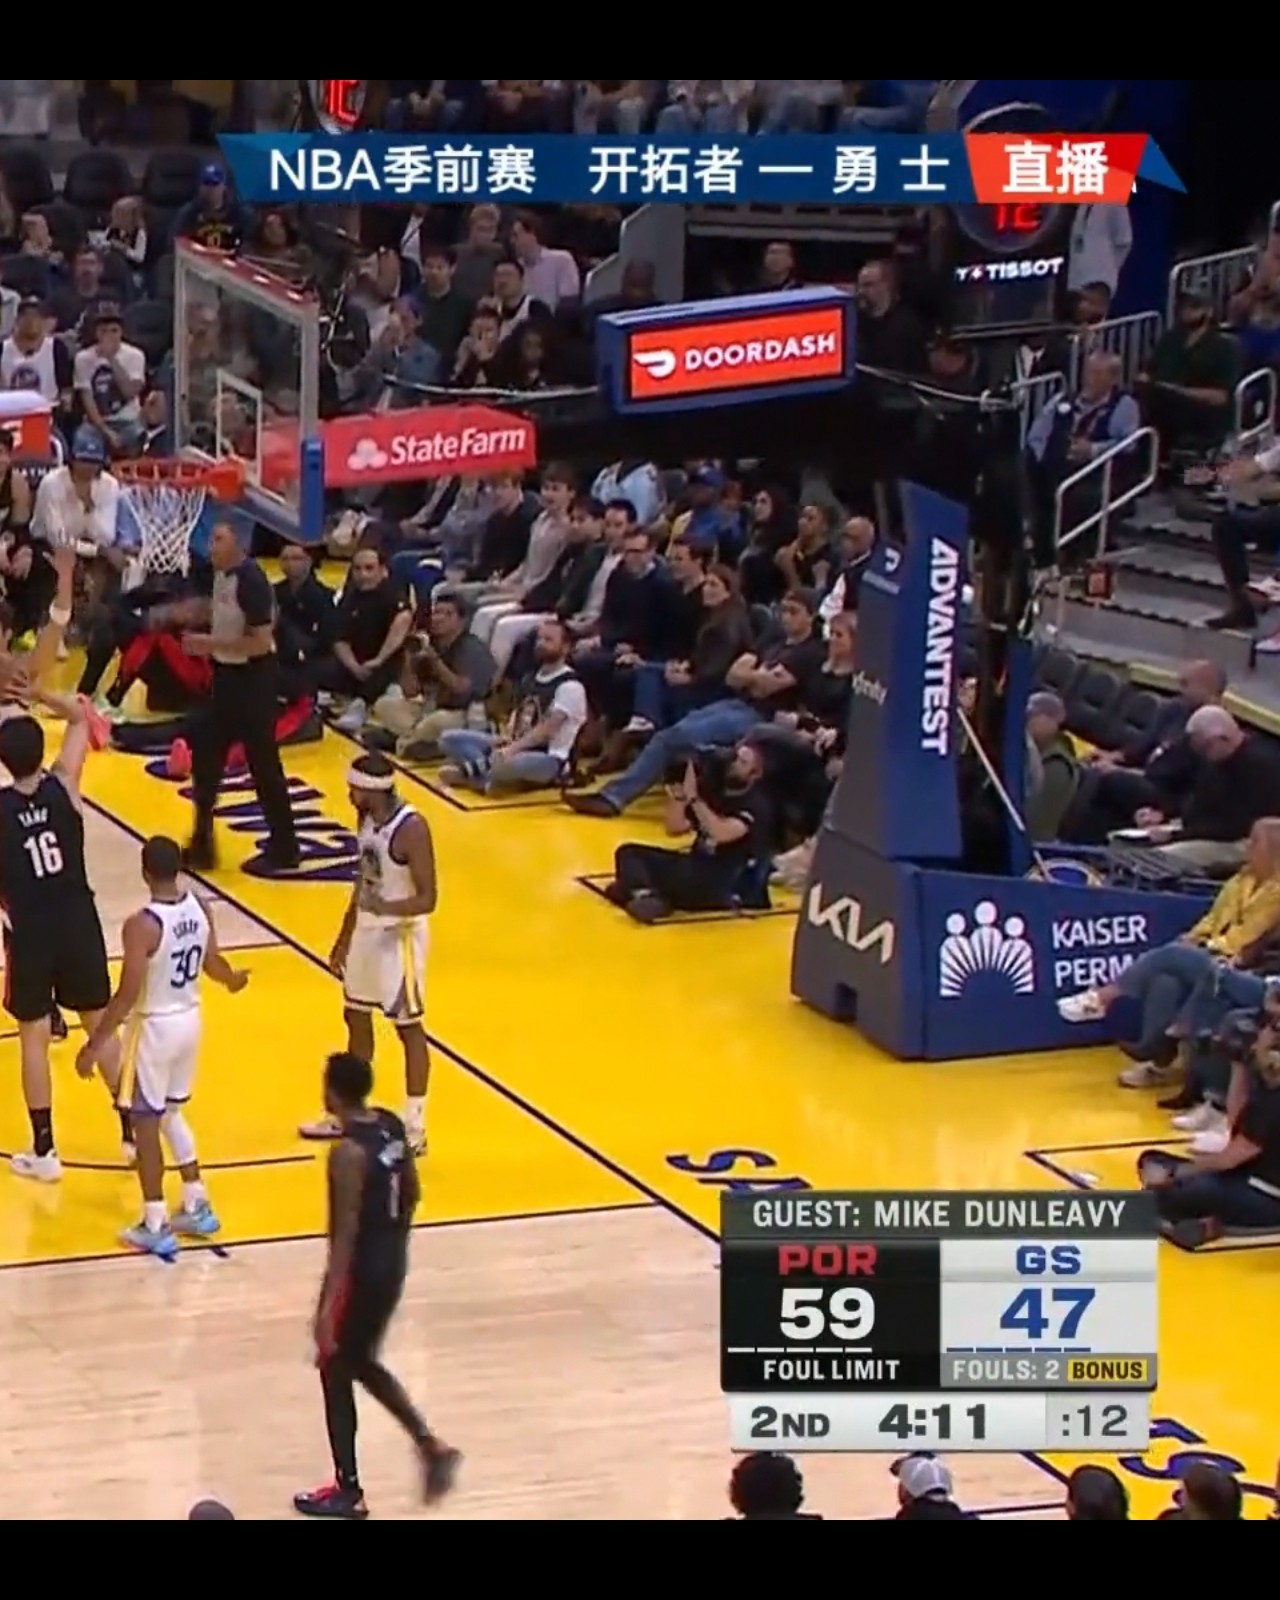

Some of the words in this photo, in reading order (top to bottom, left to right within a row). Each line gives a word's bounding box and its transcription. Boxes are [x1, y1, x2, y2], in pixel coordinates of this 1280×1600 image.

[684, 332, 836, 371] DOORDASH
[921, 536, 960, 756] ADVANTEST
[23, 830, 64, 878] 16
[807, 882, 895, 965] KIA
[1052, 914, 1148, 950] KAISER
[170, 945, 203, 989] 30
[1054, 955, 1133, 988] PERM
